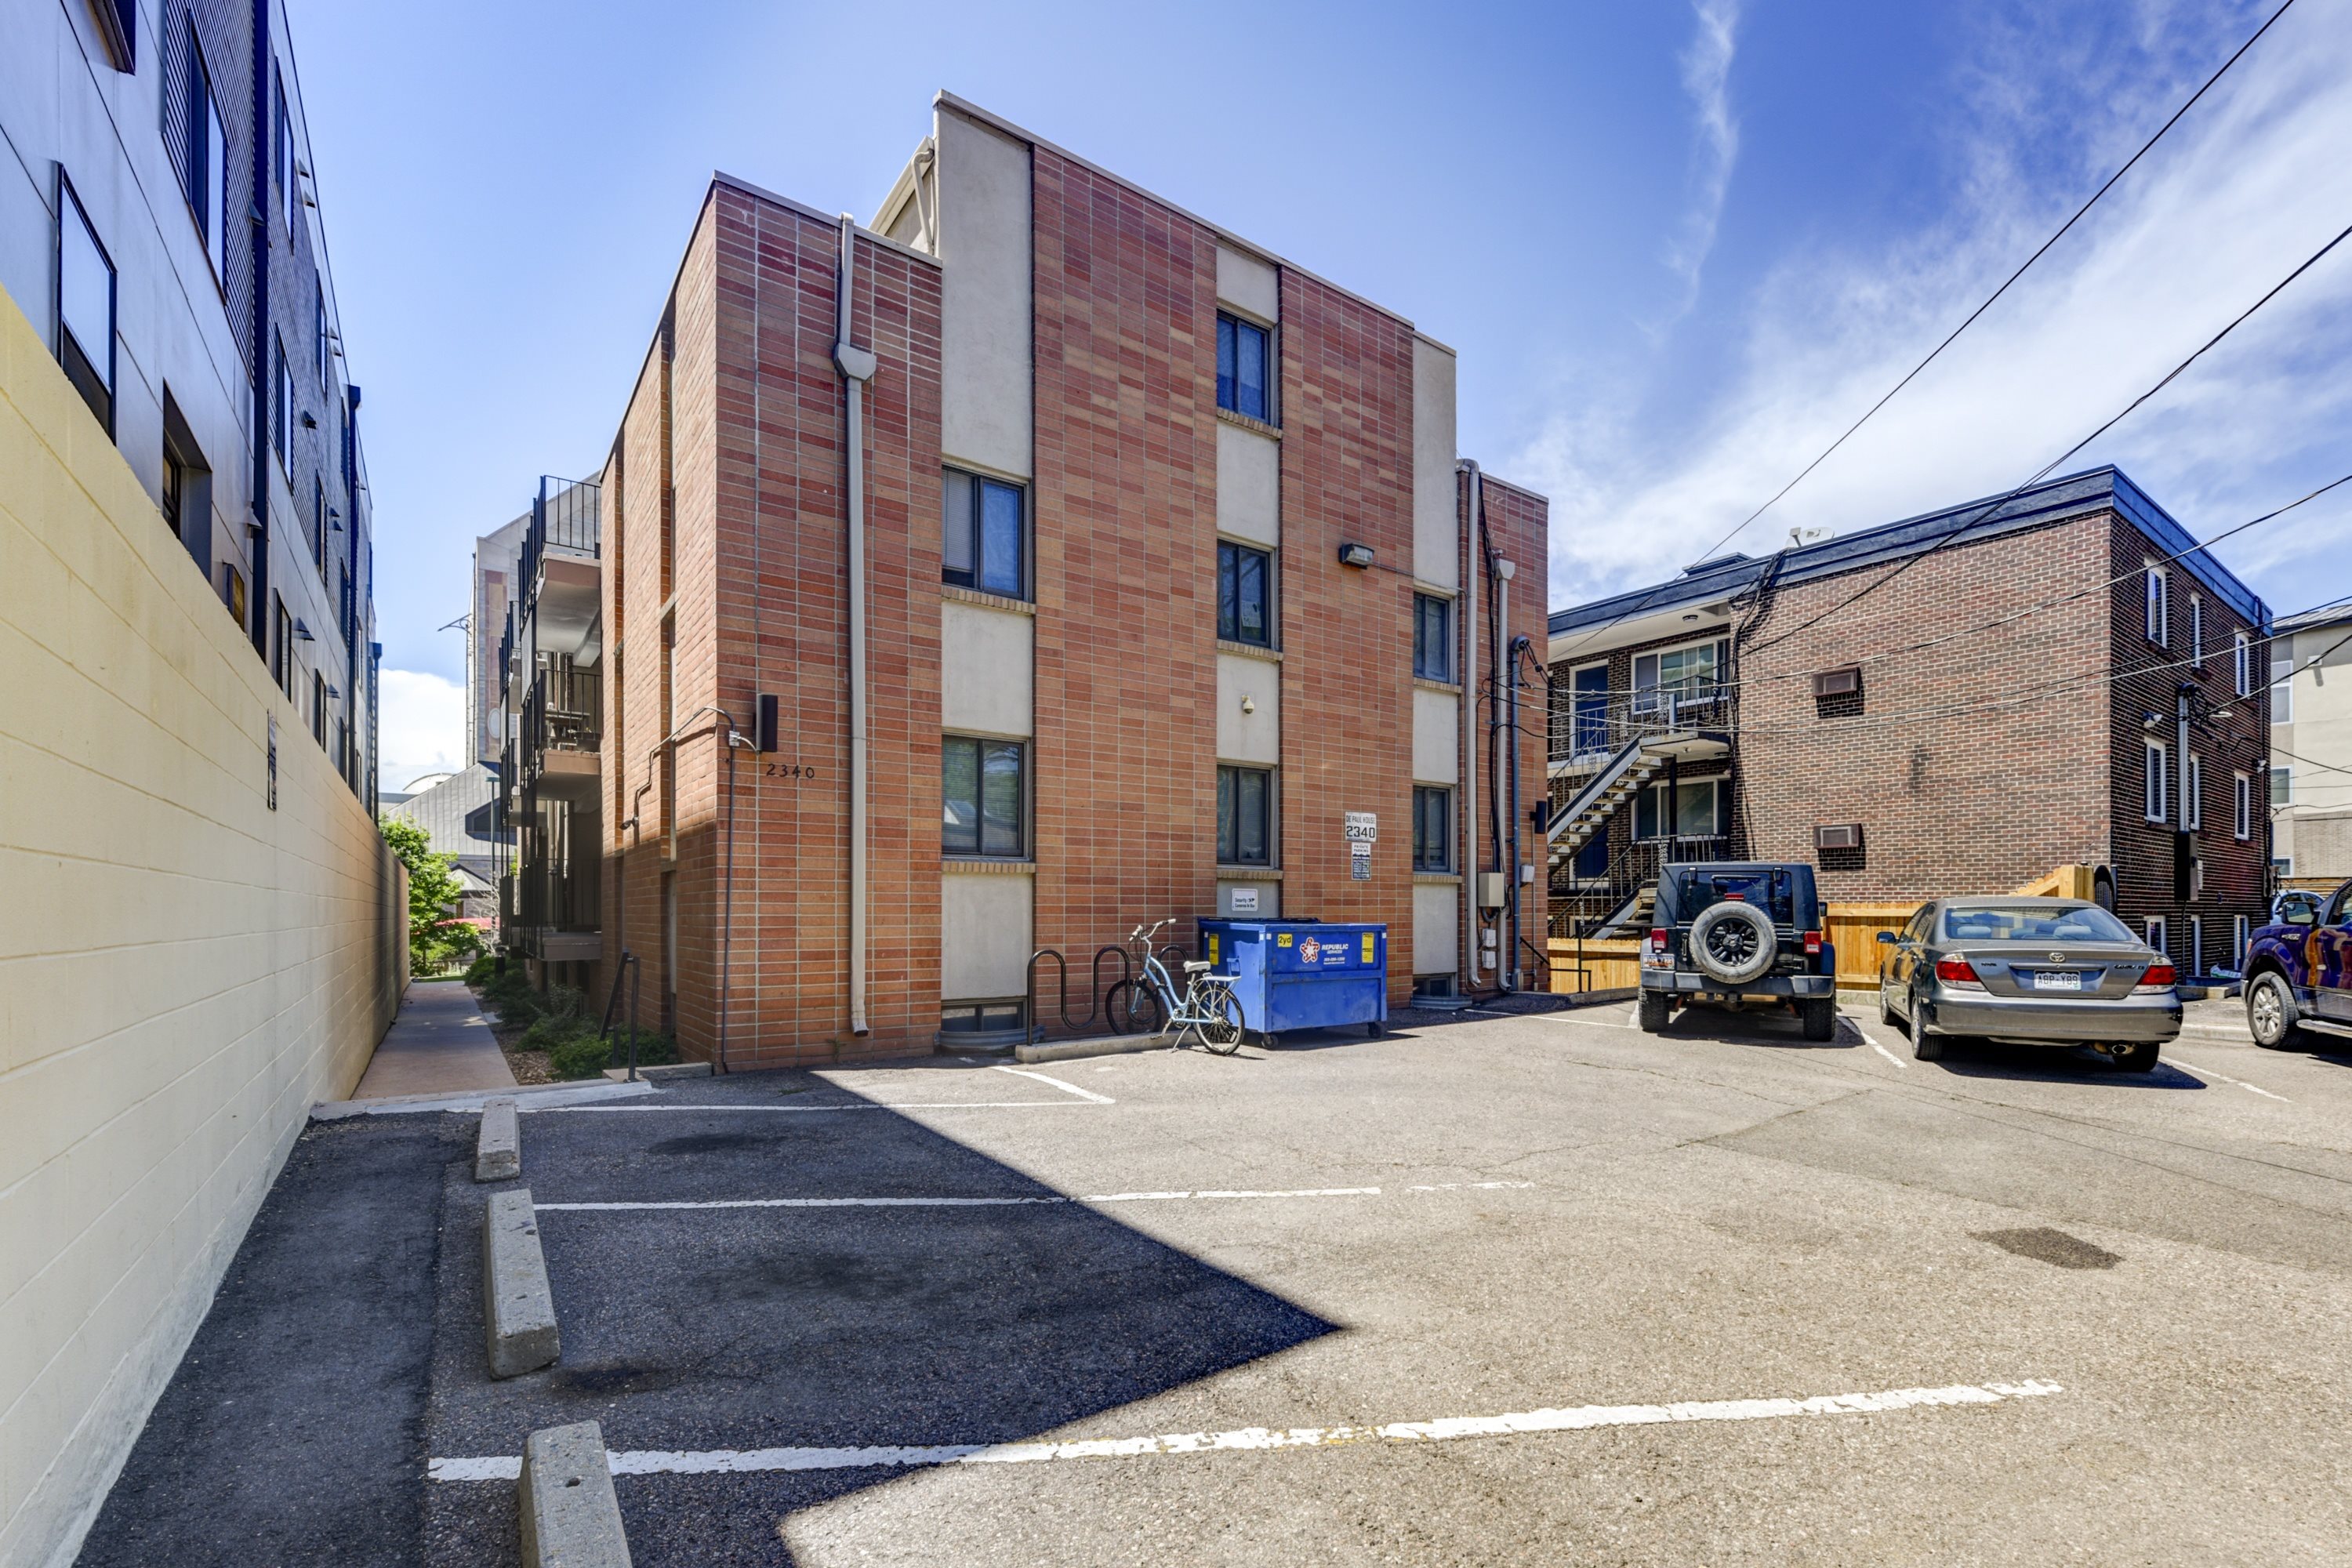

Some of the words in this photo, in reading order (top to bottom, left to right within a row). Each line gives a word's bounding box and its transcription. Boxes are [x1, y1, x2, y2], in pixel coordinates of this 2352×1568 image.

[766, 764, 815, 779] 2340
[1346, 826, 1375, 838] 2340
[1279, 936, 1291, 945] 2yd
